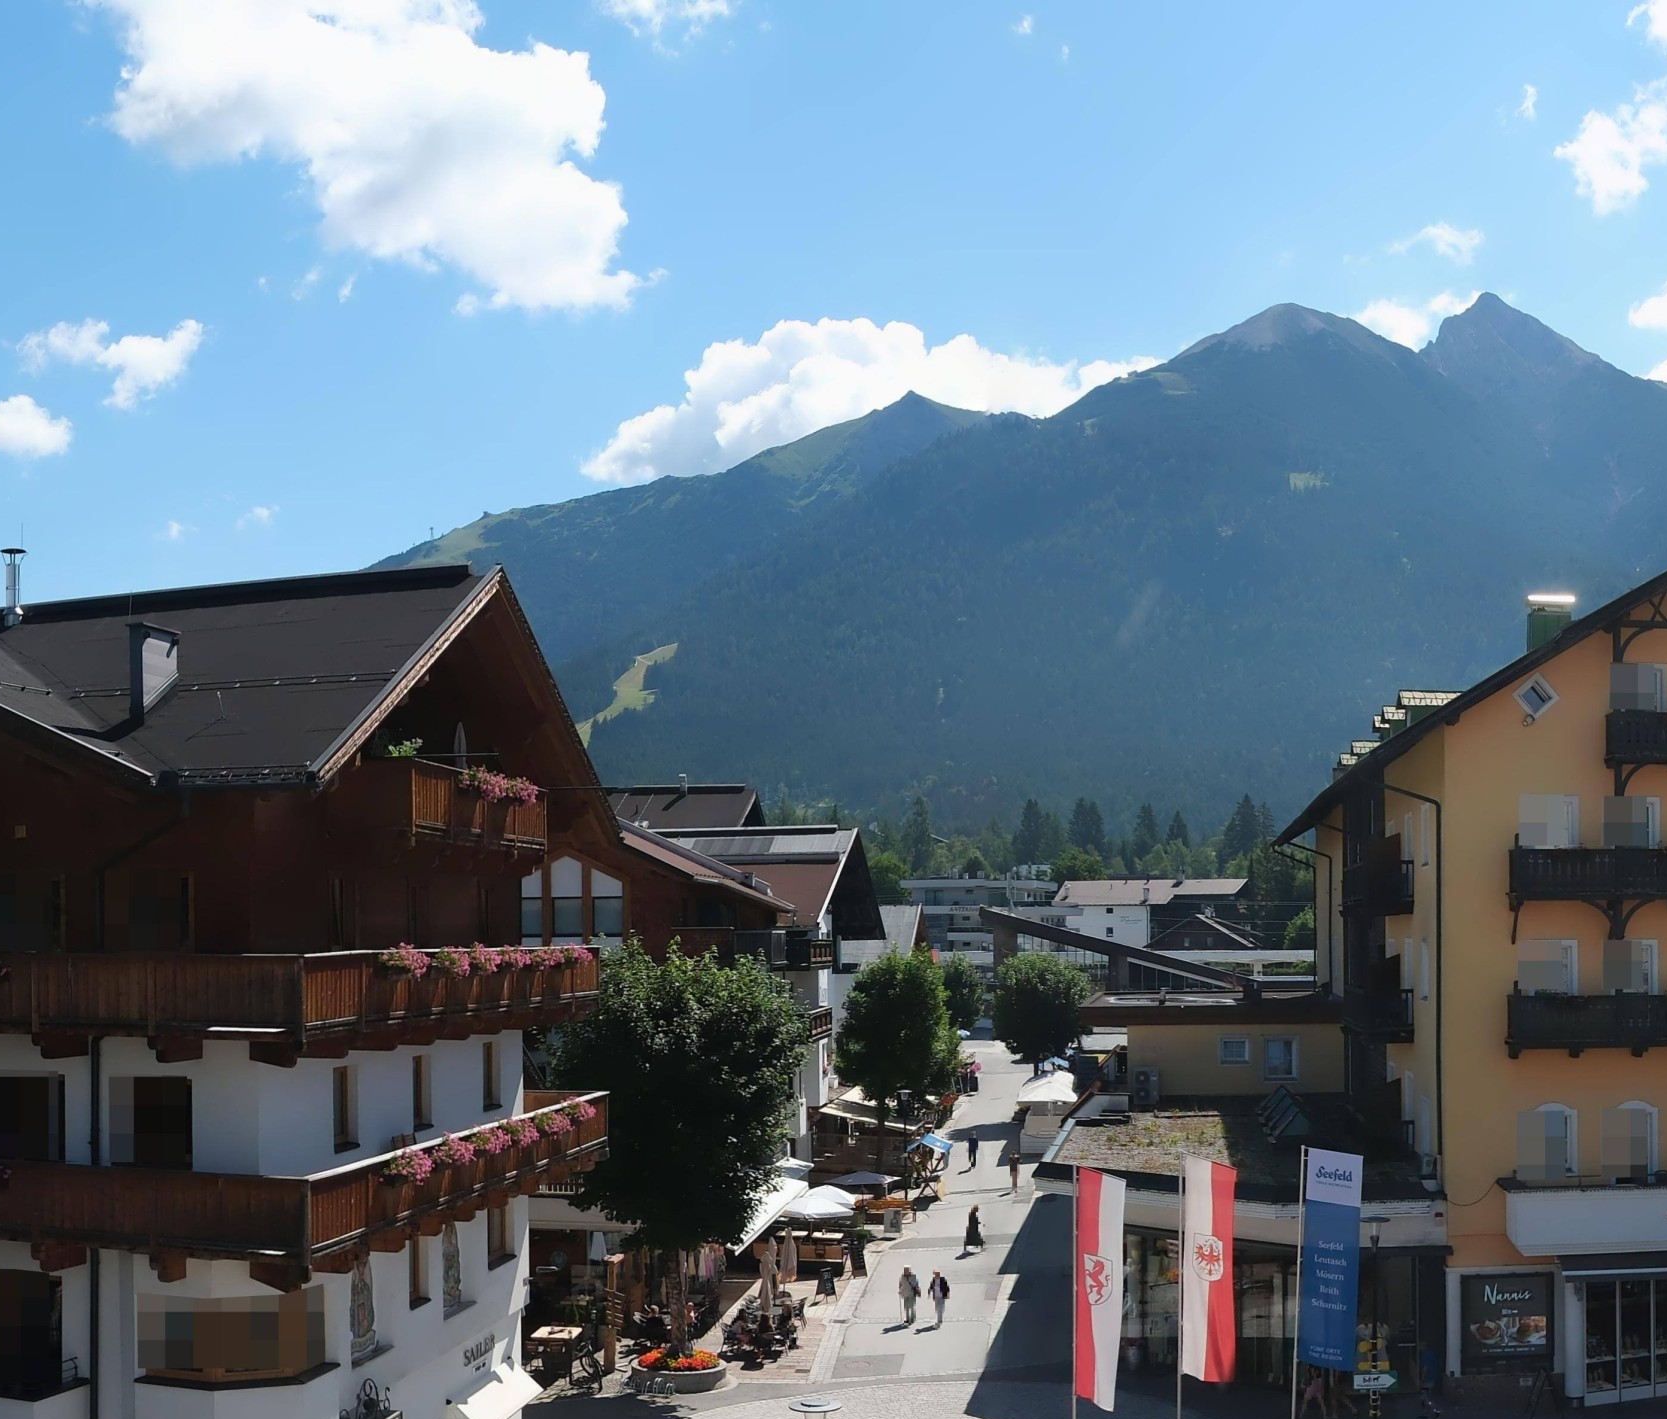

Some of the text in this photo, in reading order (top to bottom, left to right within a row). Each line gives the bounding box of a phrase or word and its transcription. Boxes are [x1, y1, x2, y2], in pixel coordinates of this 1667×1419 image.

[1316, 1165, 1353, 1182] Seefeld
[1318, 1240, 1344, 1251] Seefeld
[1314, 1254, 1347, 1267] Leutasch
[1315, 1268, 1344, 1281] Mösern
[1319, 1284, 1339, 1296] Reith
[1484, 1283, 1532, 1305] Nannis
[1311, 1298, 1347, 1311] Scharnitz
[463, 1334, 496, 1367] SAILER
